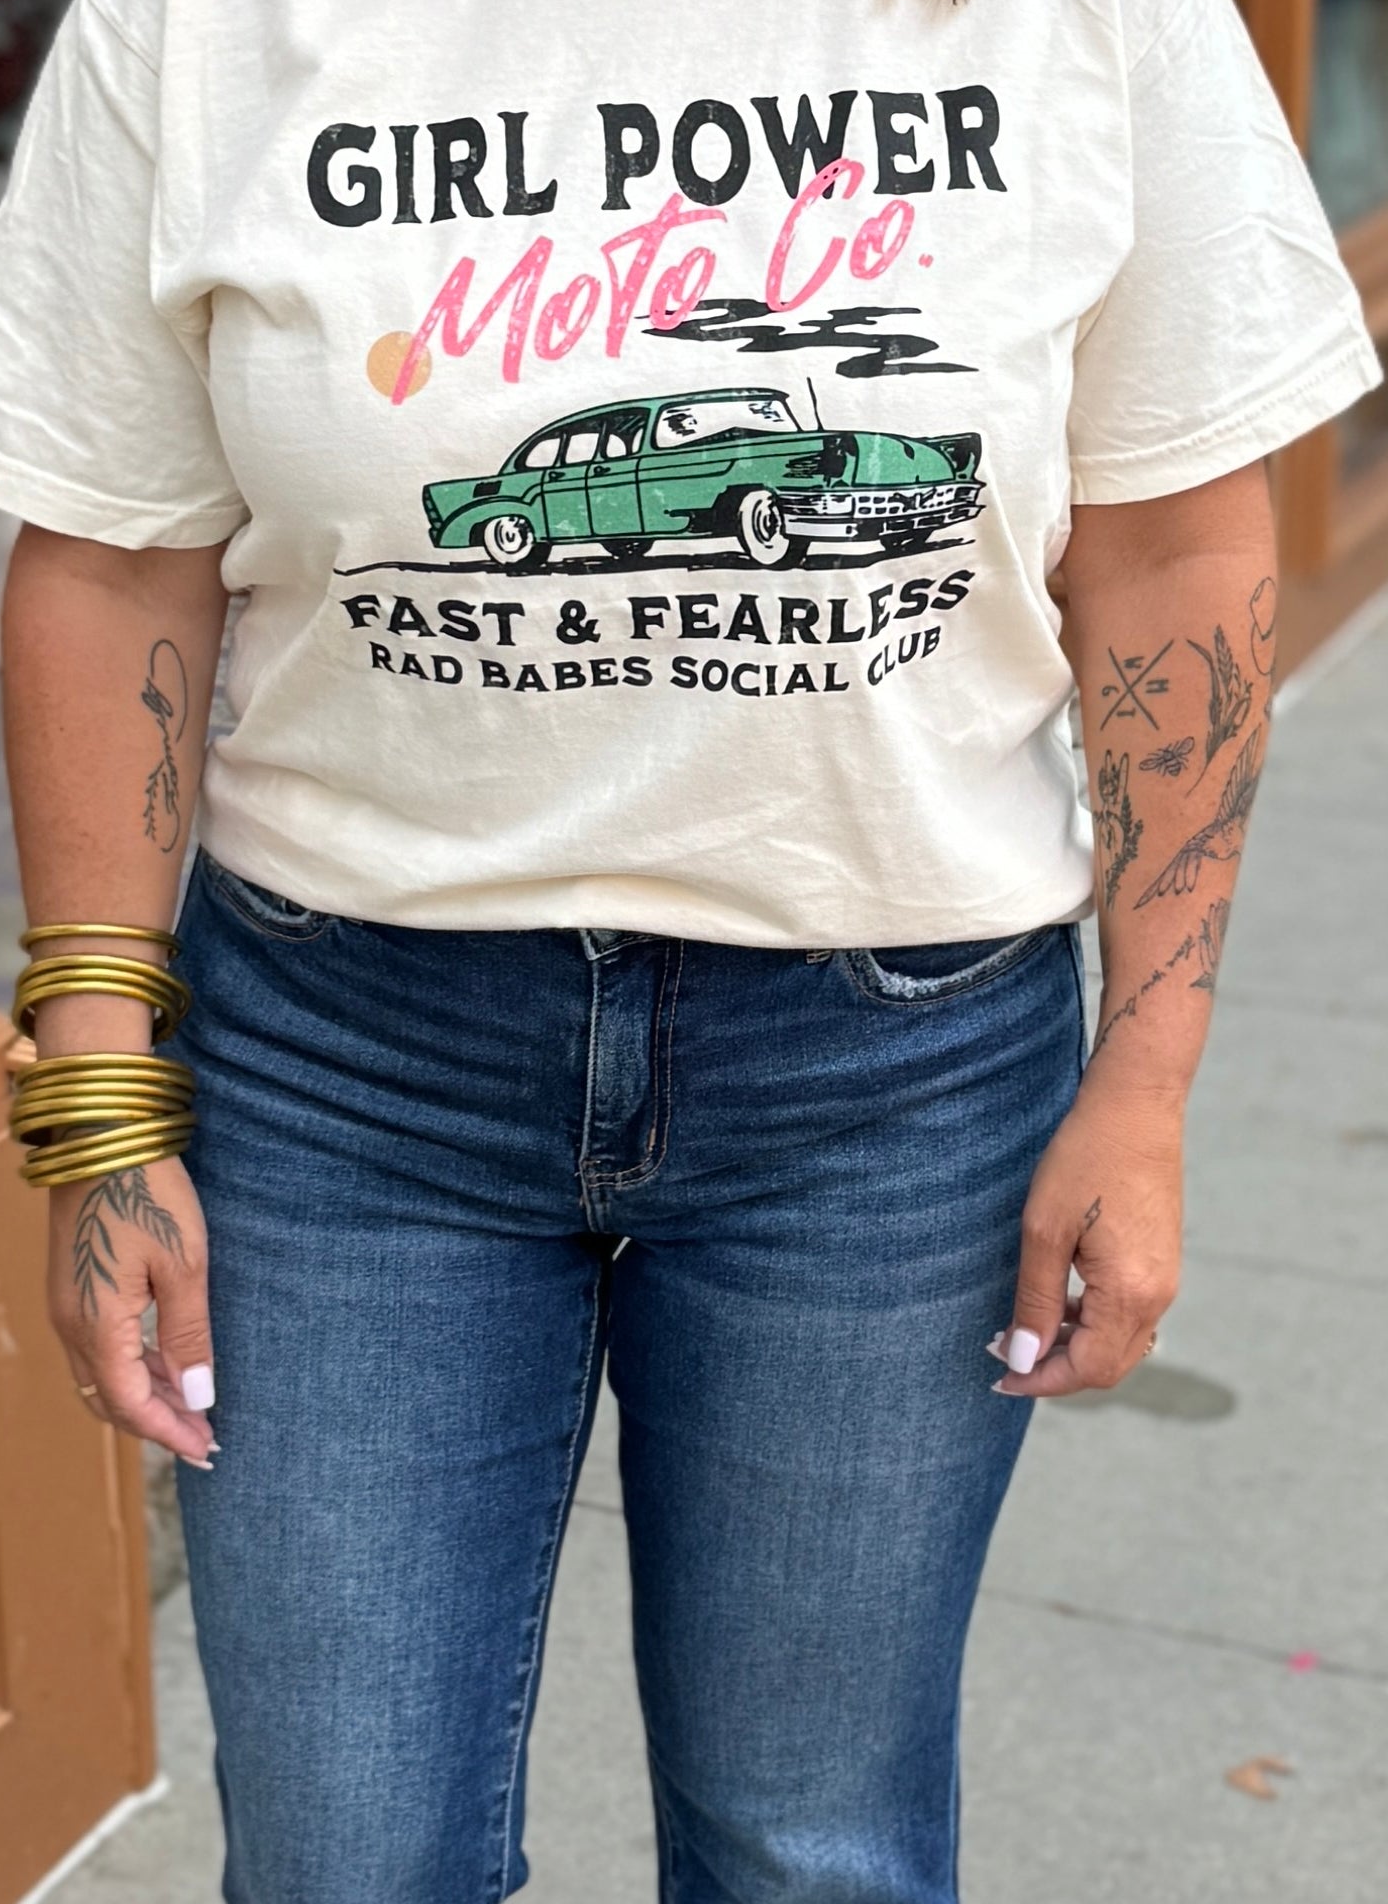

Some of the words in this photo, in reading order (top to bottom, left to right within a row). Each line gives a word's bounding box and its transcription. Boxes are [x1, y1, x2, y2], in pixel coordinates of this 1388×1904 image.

[306, 110, 559, 228] GIRL
[597, 84, 1008, 211] POWER
[764, 156, 935, 314] Co.
[338, 593, 527, 648] FAST
[555, 598, 601, 646] &
[626, 568, 976, 646] FEARLESS
[368, 639, 464, 686] RAD
[478, 655, 654, 693] BABES
[669, 654, 851, 698] SOCIAL
[867, 624, 942, 688] CLUB
